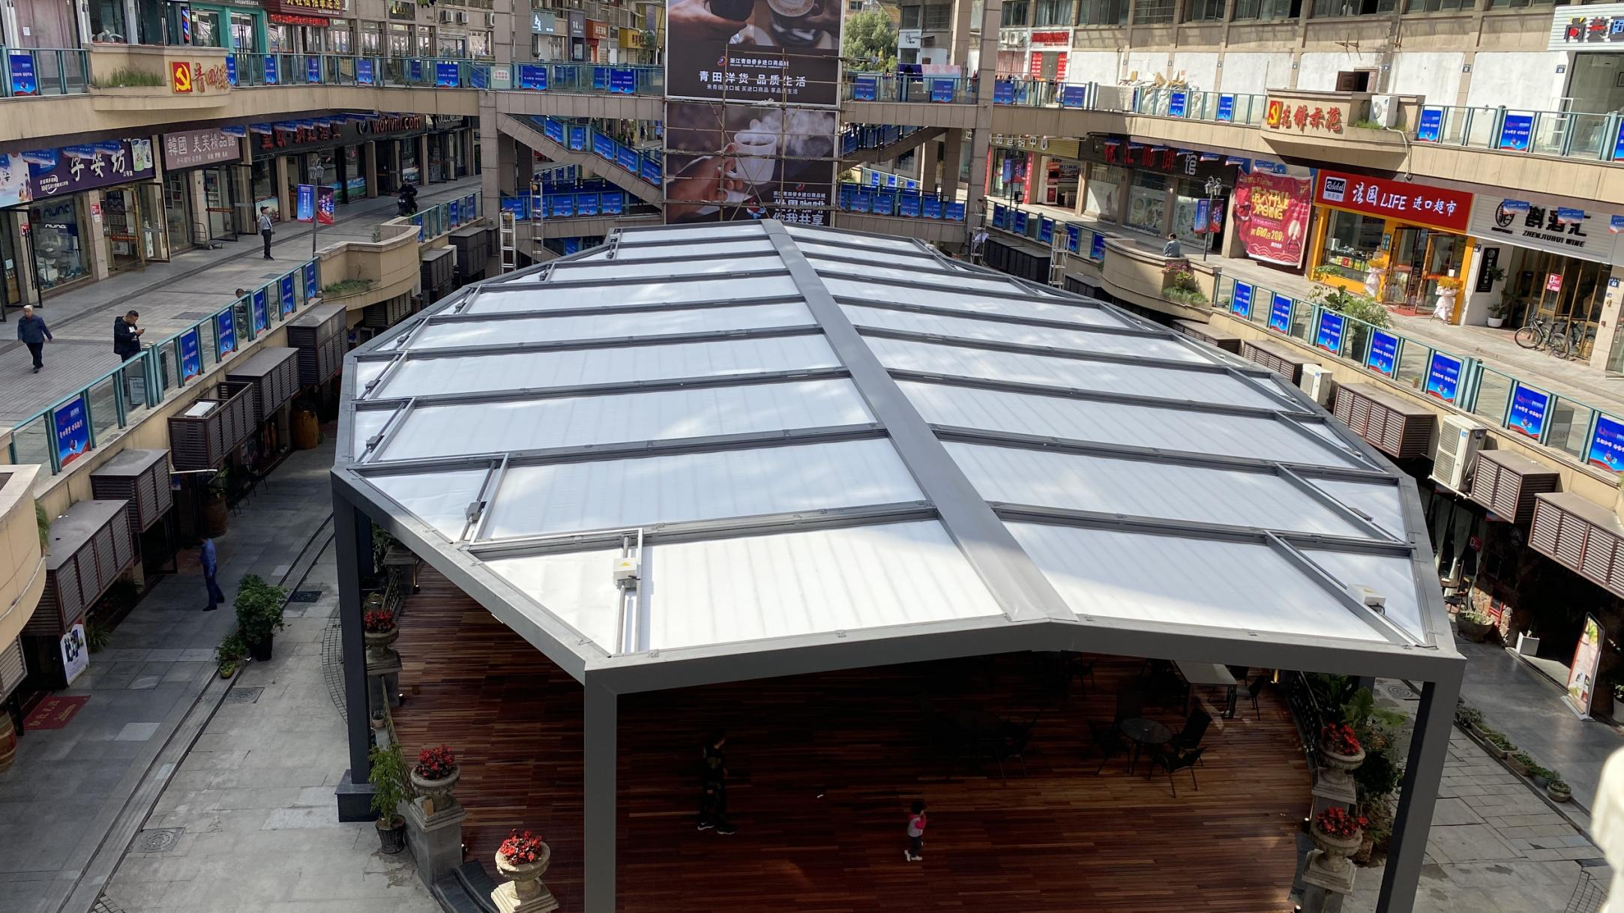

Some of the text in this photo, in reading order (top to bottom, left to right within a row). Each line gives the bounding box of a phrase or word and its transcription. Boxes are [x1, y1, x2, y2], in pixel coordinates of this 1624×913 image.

[699, 70, 806, 87] 青田洋货 品质生活
[1281, 104, 1342, 133] 先锋示范
[1352, 182, 1379, 206] 法国
[1380, 192, 1408, 210] LIFE
[1412, 195, 1458, 217] 进口超市
[1564, 239, 1586, 248] WINE
